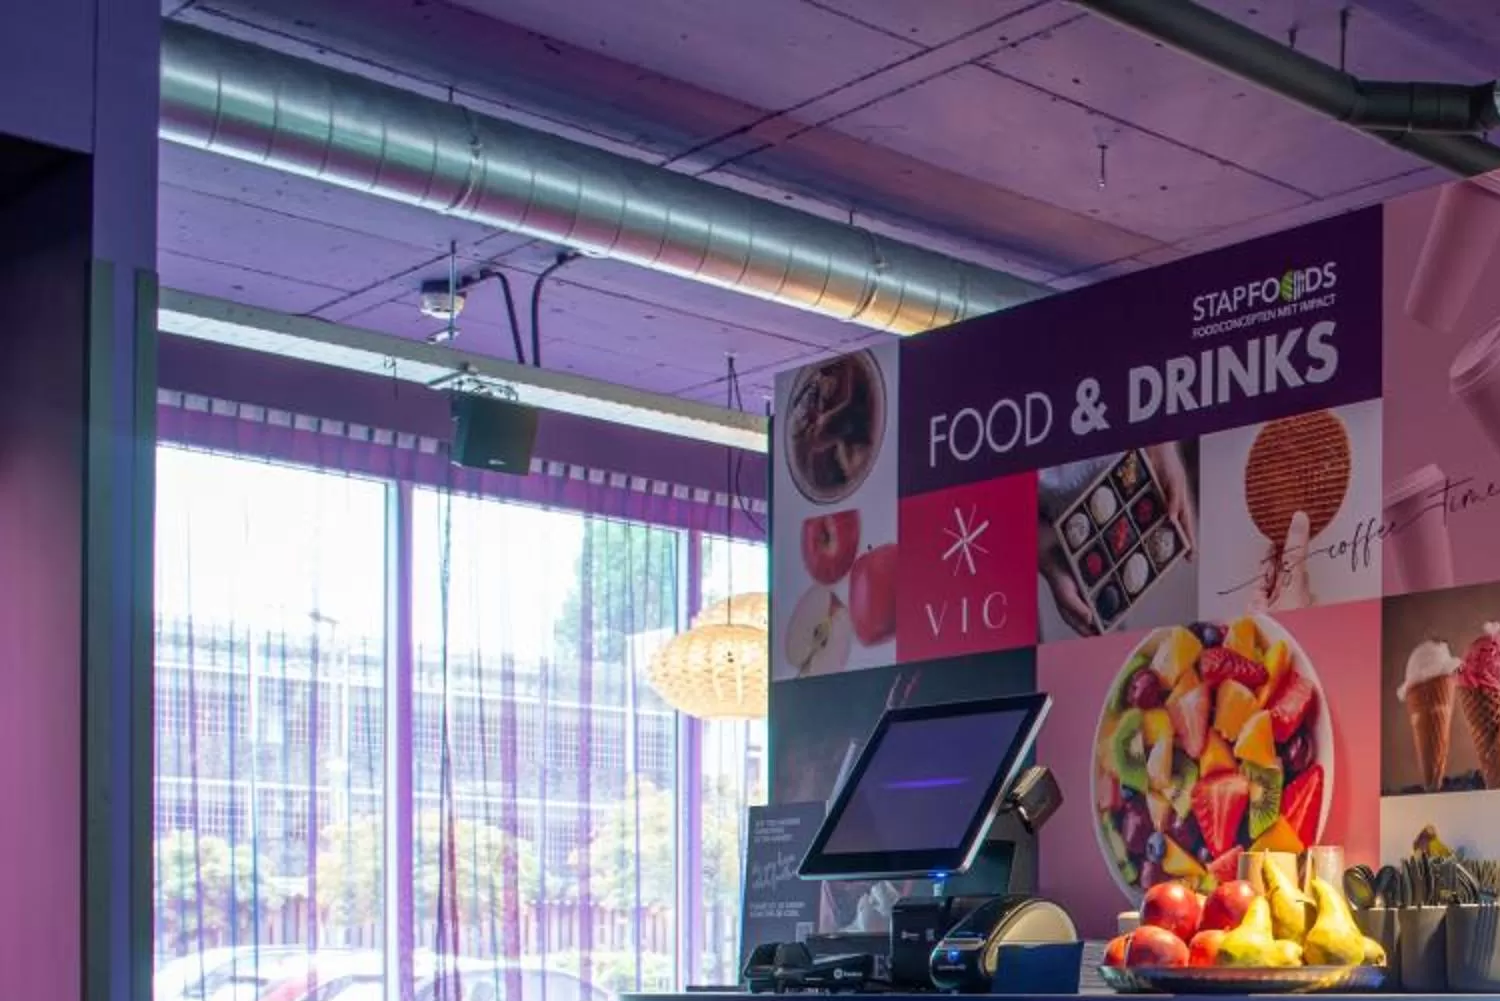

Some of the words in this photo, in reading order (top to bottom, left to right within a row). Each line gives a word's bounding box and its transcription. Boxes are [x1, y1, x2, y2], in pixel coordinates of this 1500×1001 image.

[1277, 302, 1298, 318] MET
[1299, 293, 1337, 314] IMPACT
[928, 391, 1053, 468] FOOD
[1070, 377, 1110, 436] &
[1127, 320, 1339, 425] DRINKS
[1312, 516, 1406, 573] coffee
[924, 590, 1009, 637] VIC
